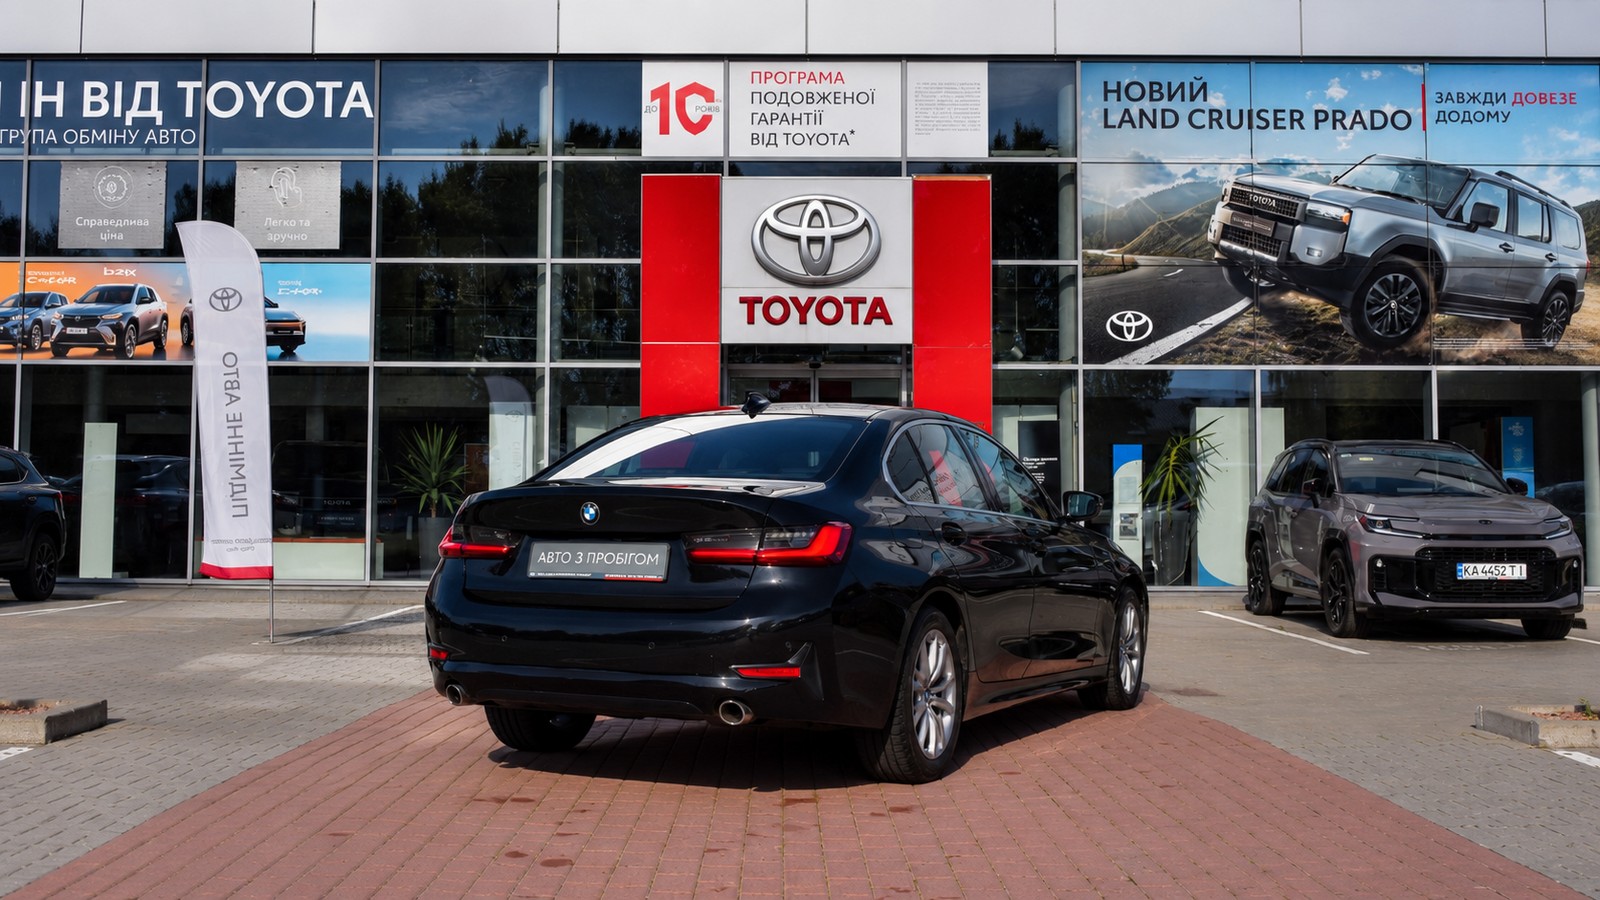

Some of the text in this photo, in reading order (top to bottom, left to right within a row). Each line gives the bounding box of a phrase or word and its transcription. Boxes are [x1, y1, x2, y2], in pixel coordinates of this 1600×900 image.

[751, 71, 844, 85] ПРОГРАМА
[751, 88, 875, 106] ПОДОВЖЕНОЇ
[1104, 77, 1208, 102] НОВИЙ
[83, 81, 162, 125] ВІД
[177, 81, 374, 118] TOYOTA
[1435, 92, 1577, 107] ЗАВЖДИ ДОВЕЗЕ
[751, 110, 823, 126] ГАРАНТІЇ
[1103, 108, 1412, 131] LAND CRUISER PRADO
[1435, 111, 1511, 125] ДОДОМУ
[63, 129, 139, 144] ОБМІНУ
[145, 129, 196, 144] АВТО
[751, 133, 778, 147] ВІД
[75, 217, 149, 228] Справедлива
[264, 218, 296, 230] Легко
[100, 230, 124, 242] ціна
[267, 233, 308, 244] зручно
[739, 296, 893, 326] TOYOTA
[537, 551, 659, 566] АВТО З ПРОБІГОМ
[1481, 565, 1507, 577] 4452
